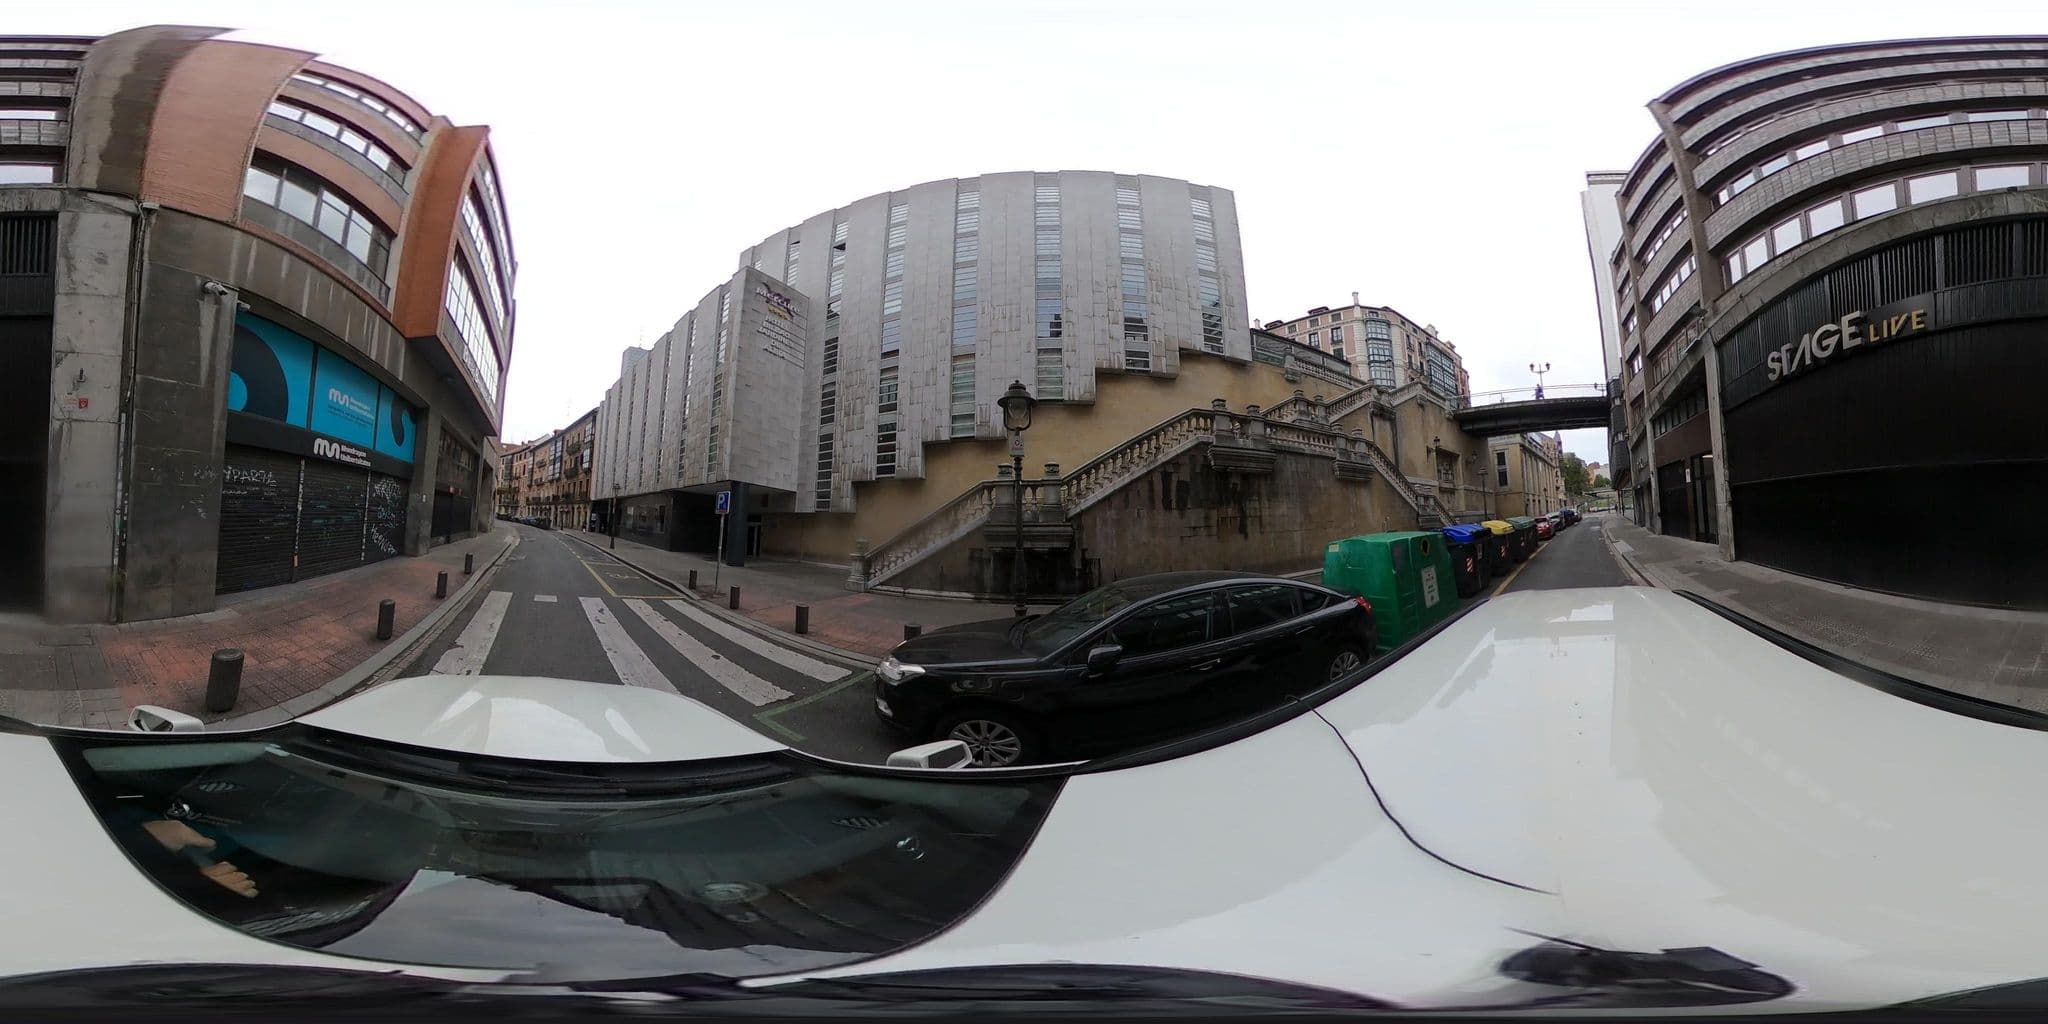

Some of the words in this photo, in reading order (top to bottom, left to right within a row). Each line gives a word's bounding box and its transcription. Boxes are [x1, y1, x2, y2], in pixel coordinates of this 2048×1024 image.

[1767, 310, 1863, 382] STAGE
[1869, 309, 1927, 343] LIVE
[718, 493, 725, 509] P
